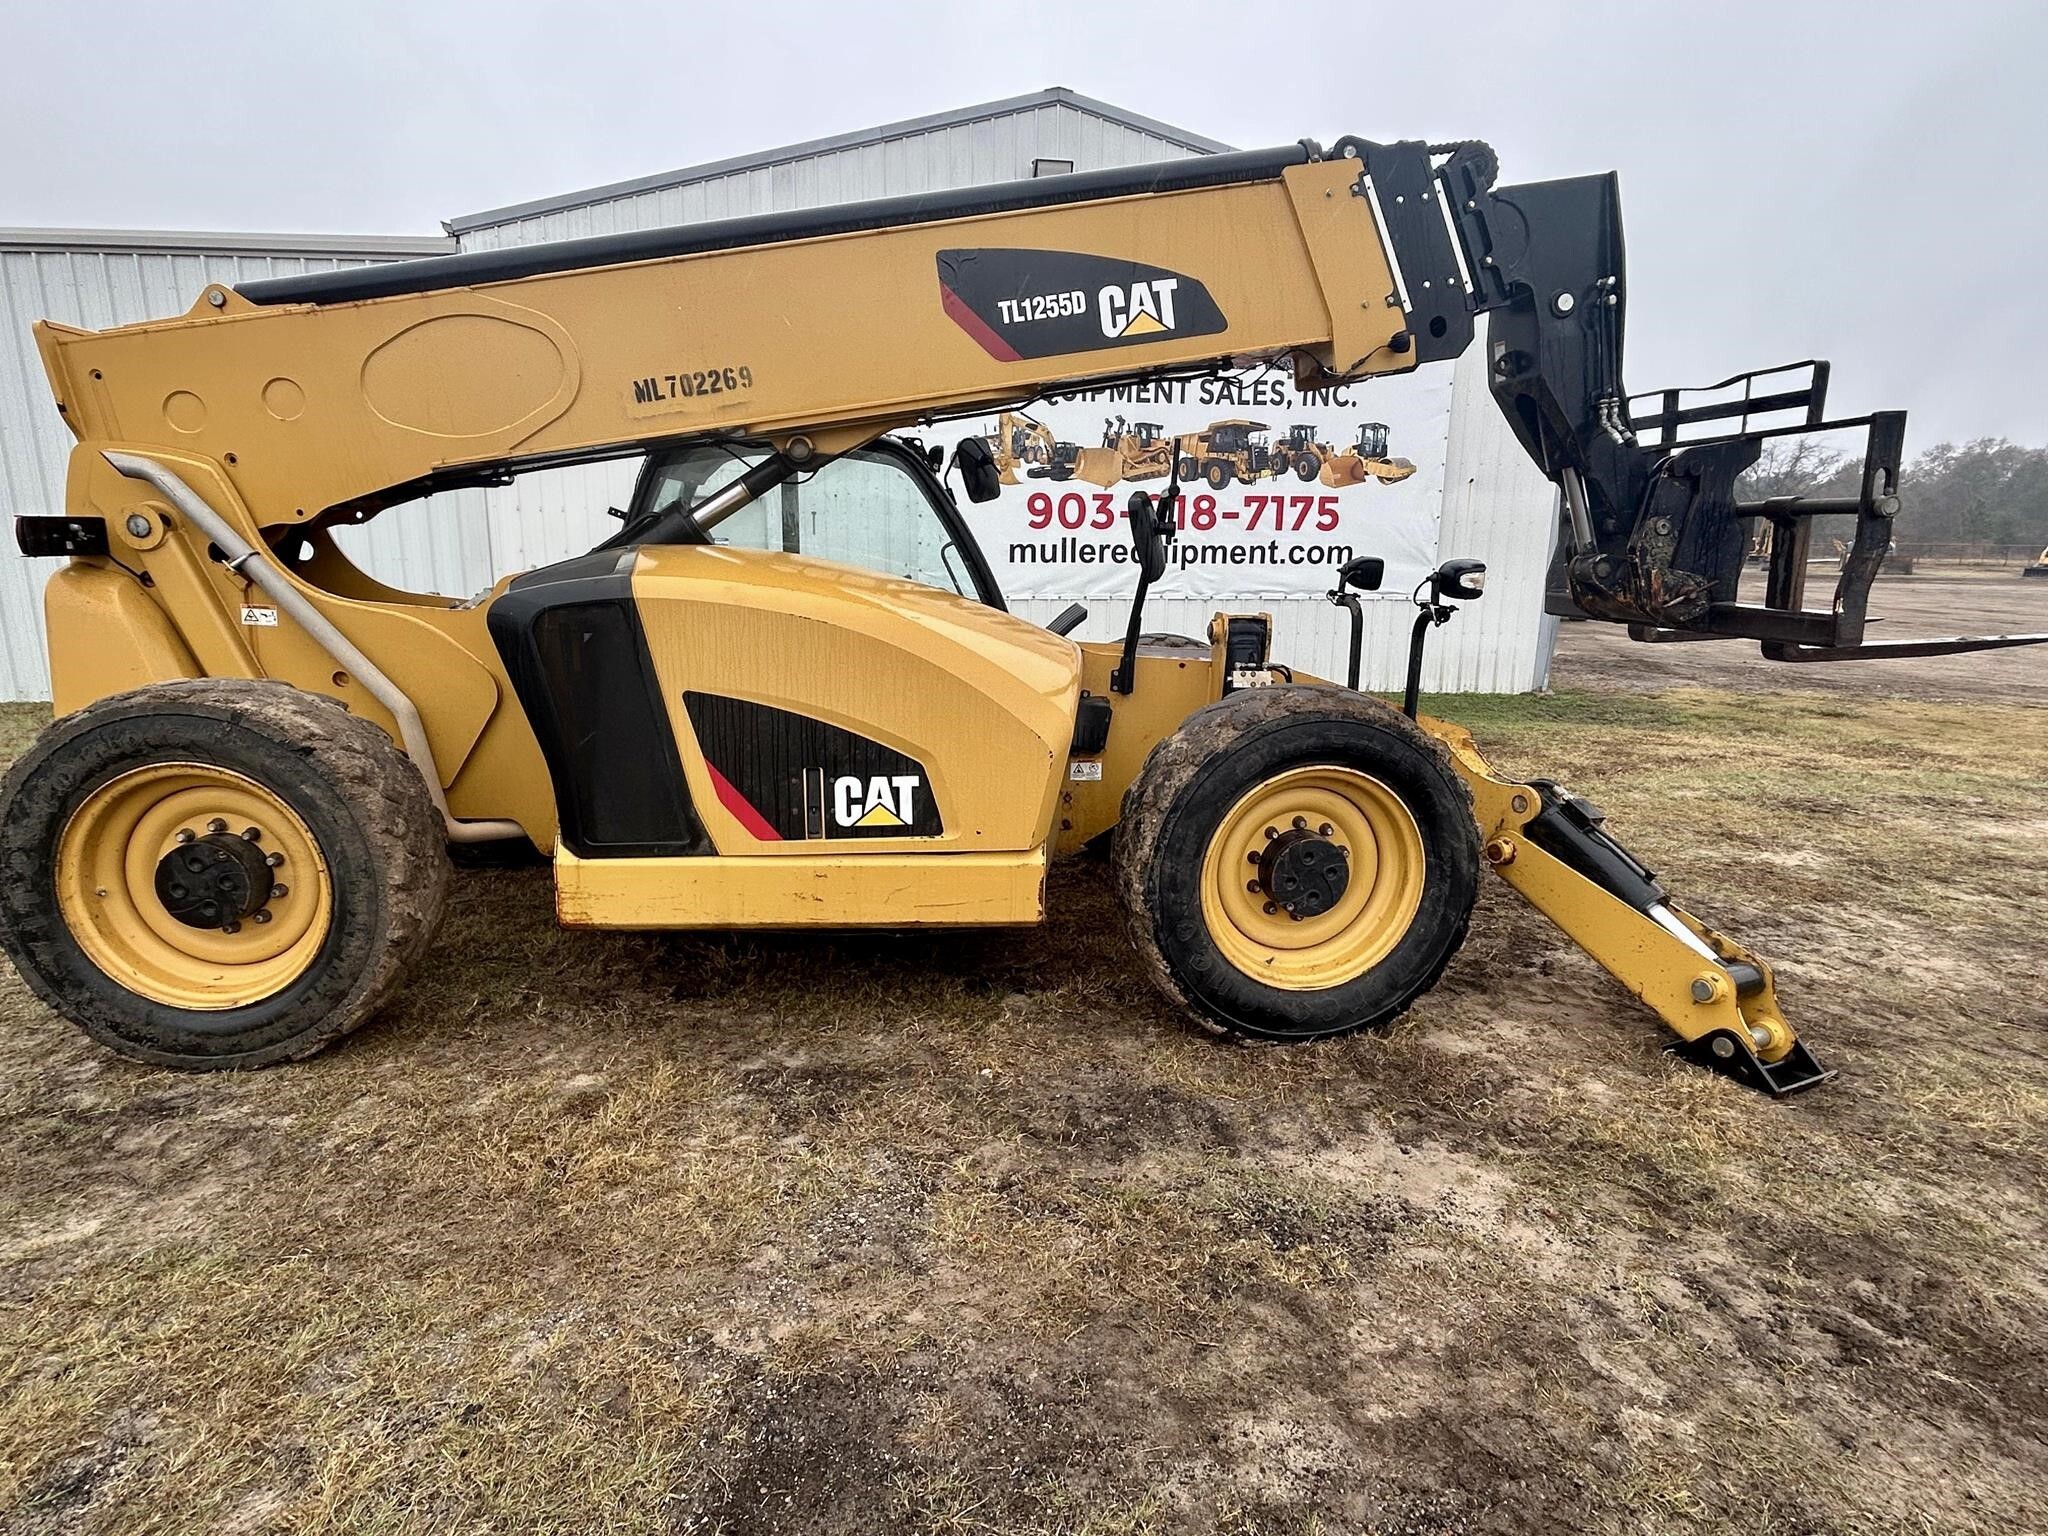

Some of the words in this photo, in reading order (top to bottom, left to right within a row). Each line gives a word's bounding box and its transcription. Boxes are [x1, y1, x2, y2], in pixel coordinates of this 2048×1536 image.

[998, 290, 1086, 324] TL1255D
[1098, 278, 1178, 338] CAT
[633, 366, 753, 404] ML702269
[1200, 378, 1292, 409] SALES,
[1302, 383, 1357, 408] INC.
[1027, 492, 1340, 532] 903-18-7175
[1009, 537, 1352, 571] mullereipment.com
[834, 775, 920, 827] CAT
